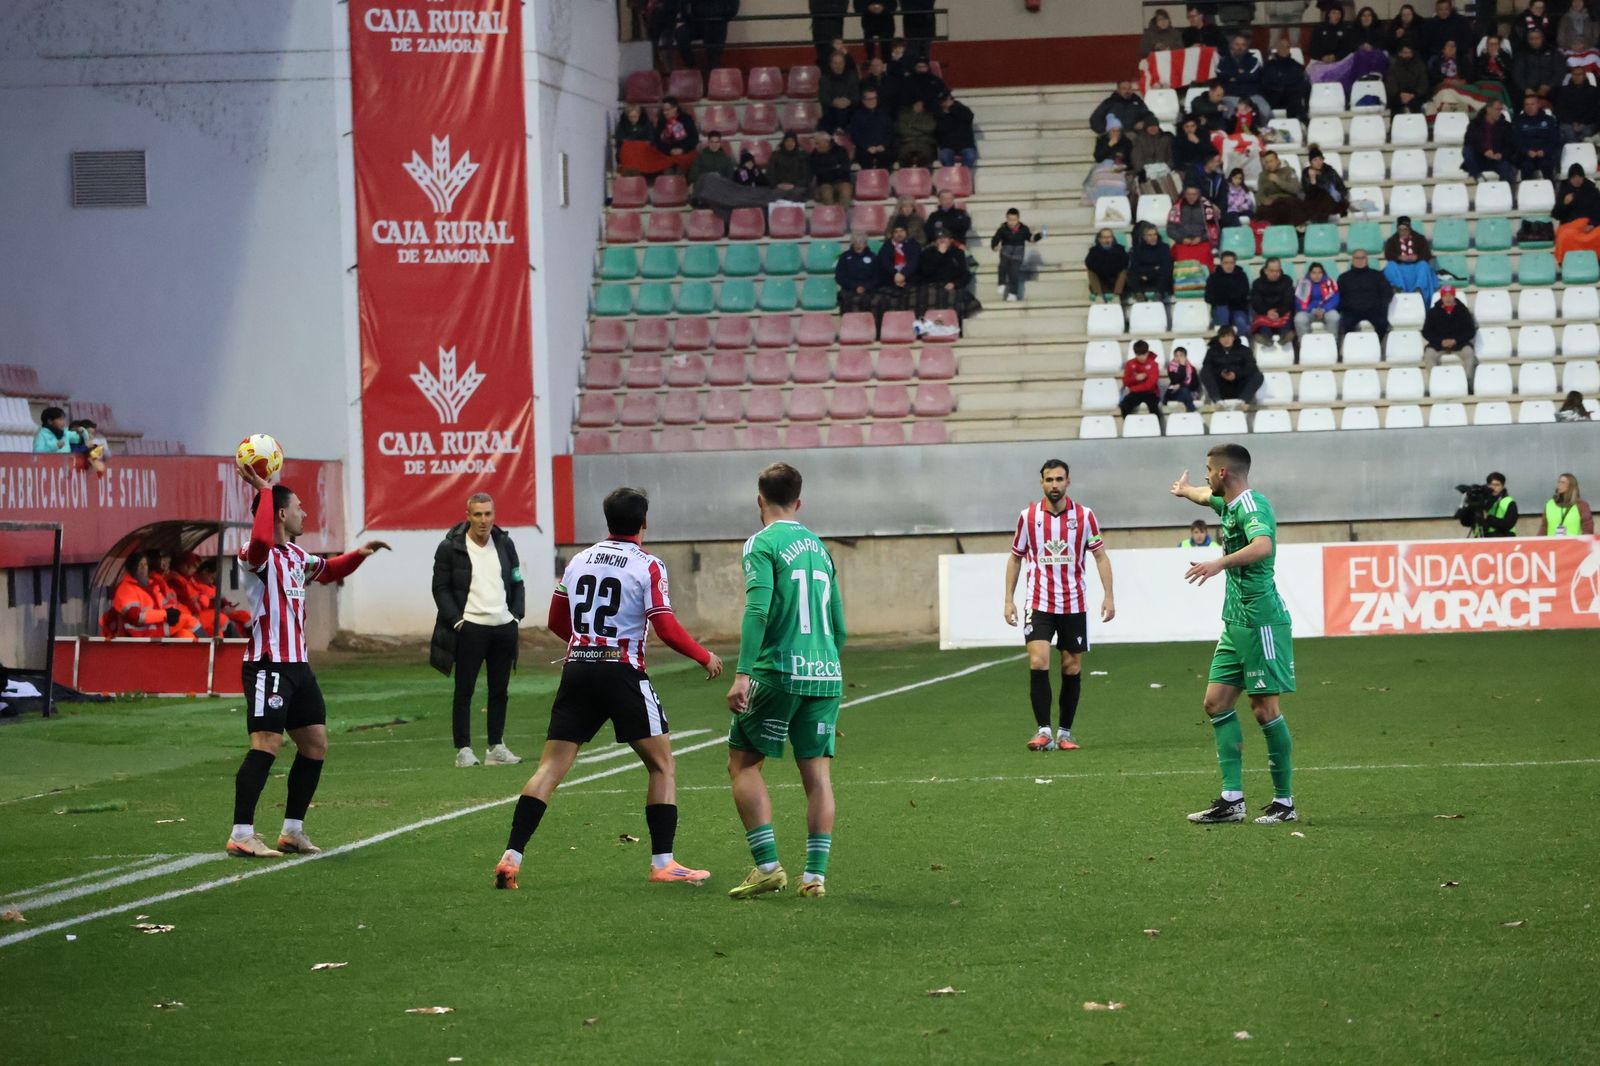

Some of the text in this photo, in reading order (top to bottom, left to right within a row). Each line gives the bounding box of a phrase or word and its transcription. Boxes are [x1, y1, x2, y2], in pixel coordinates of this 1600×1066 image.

[364, 8, 508, 34] CAJA RURAL
[390, 38, 484, 53] DE ZAMORA
[372, 220, 515, 245] CAJA RURAL
[398, 249, 490, 263] DE ZAMORA
[378, 430, 521, 456] CAJA RURAL
[404, 459, 496, 475] DE ZAMORA
[98, 467, 113, 508] DE
[119, 467, 157, 508] STAND
[594, 552, 628, 568] SANCHO
[1349, 543, 1556, 589] FUNDACIÓN
[574, 574, 622, 638] 22
[791, 568, 831, 636] 17
[1350, 587, 1557, 631] ZAMORACF
[271, 672, 280, 693] 7
